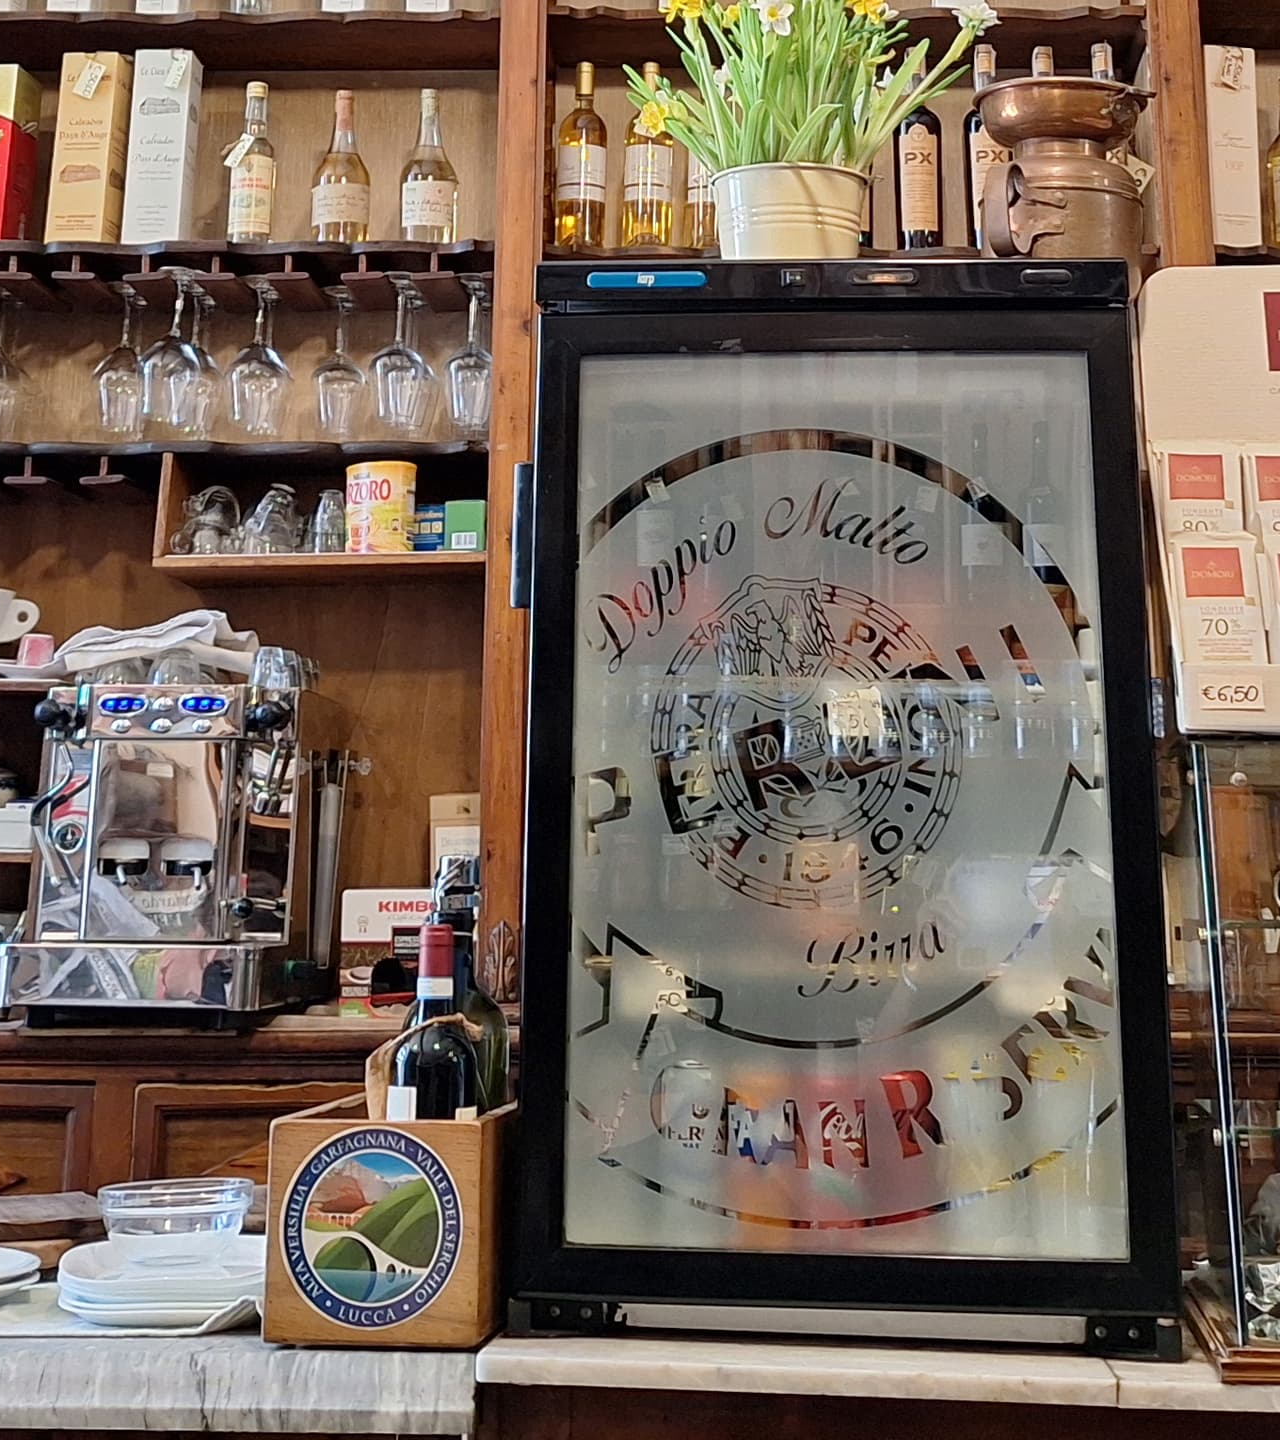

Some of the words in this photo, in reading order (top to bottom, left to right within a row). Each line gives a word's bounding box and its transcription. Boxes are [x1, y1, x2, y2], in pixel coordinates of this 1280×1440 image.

[904, 151, 933, 165] PX
[976, 149, 1005, 163] PX
[346, 478, 392, 505] RZORO
[584, 515, 737, 675] Doppio
[763, 478, 929, 565] Malto
[1200, 684, 1260, 705] €6,50
[797, 919, 947, 998] Birra
[310, 1133, 407, 1175] GARFAGNANA
[415, 1149, 449, 1195] VALLE
[287, 1183, 307, 1268] VERSILIA
[442, 1194, 457, 1229] DEL
[295, 1269, 321, 1299] ALTA
[413, 1232, 457, 1303] SERCHIO
[337, 1305, 398, 1326] LUCCA
